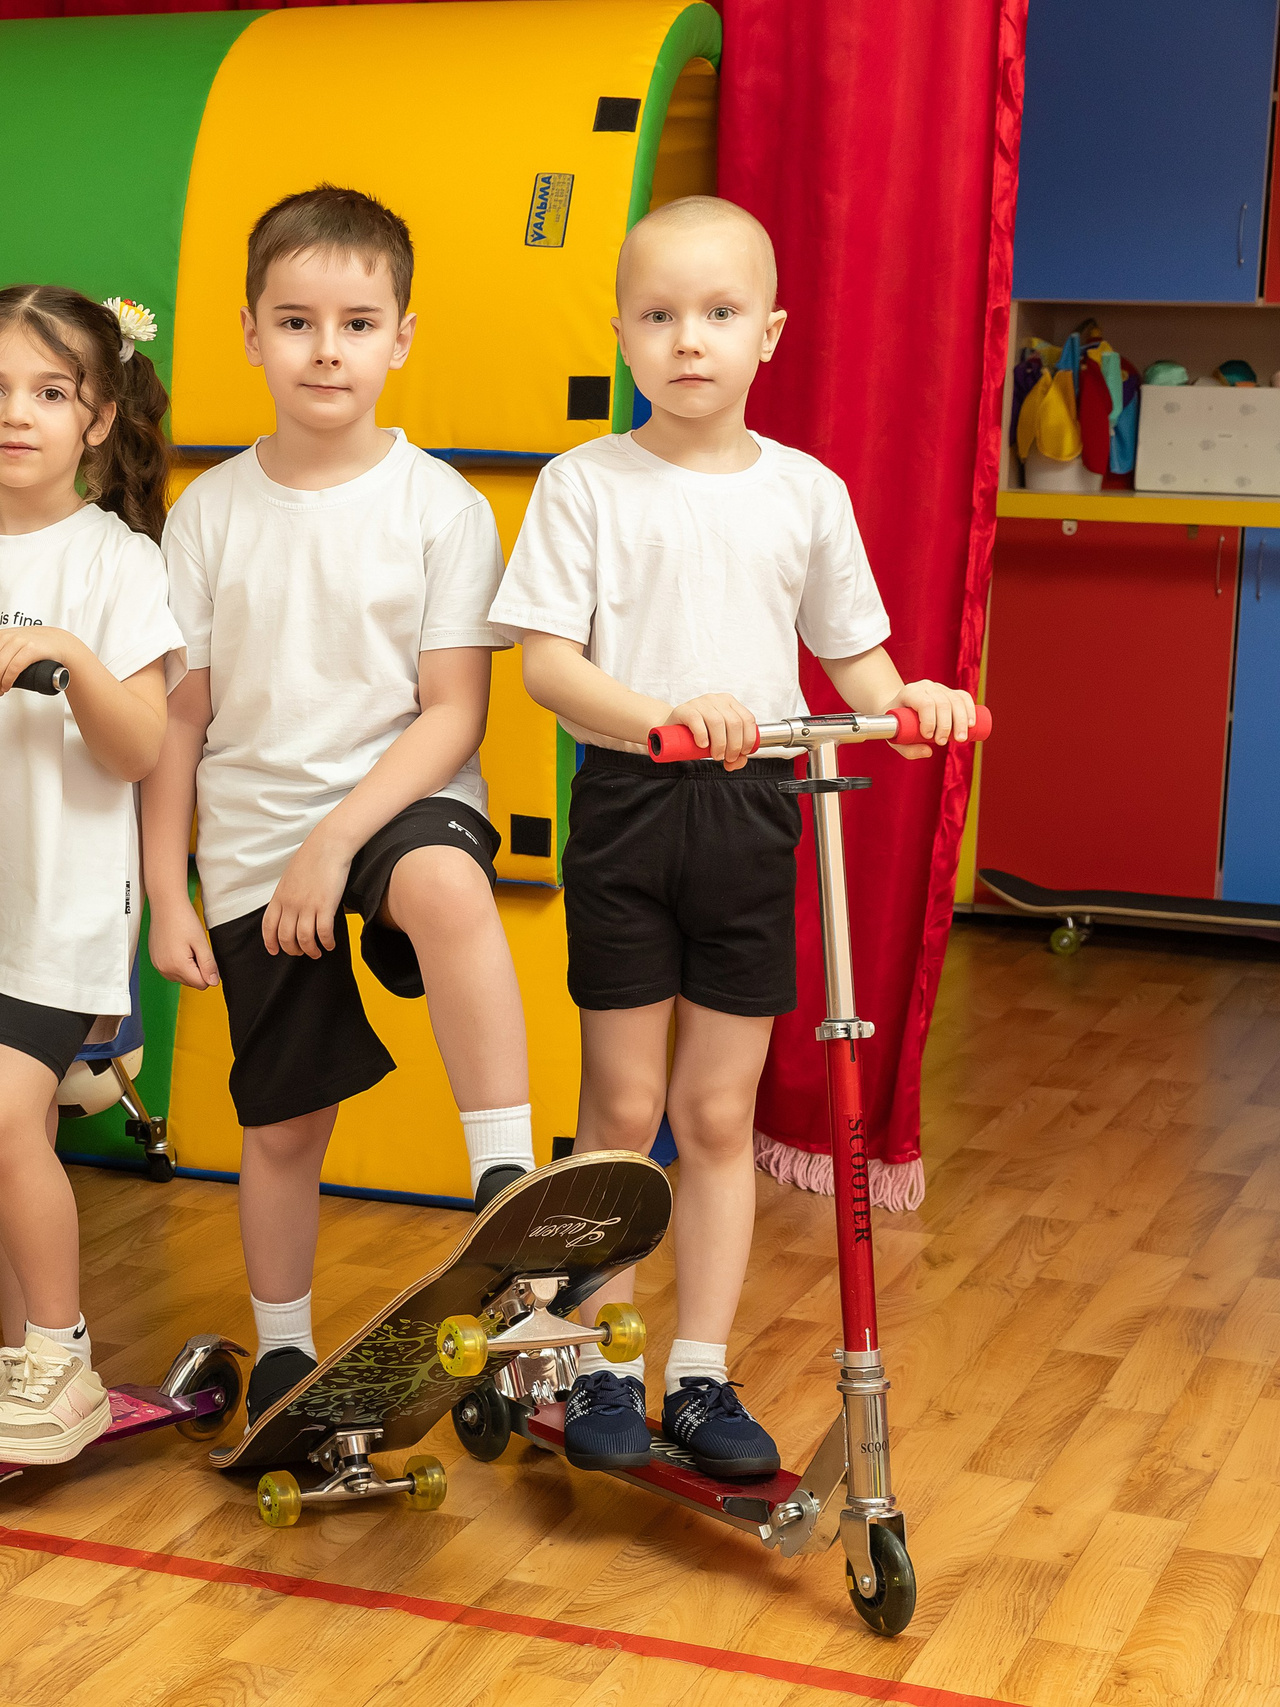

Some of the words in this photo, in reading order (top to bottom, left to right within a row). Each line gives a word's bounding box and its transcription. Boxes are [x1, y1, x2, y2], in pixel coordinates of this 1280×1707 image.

[0, 611, 10, 626] is
[848, 1118, 870, 1244] SCOOTER
[528, 1214, 622, 1248] Larsen
